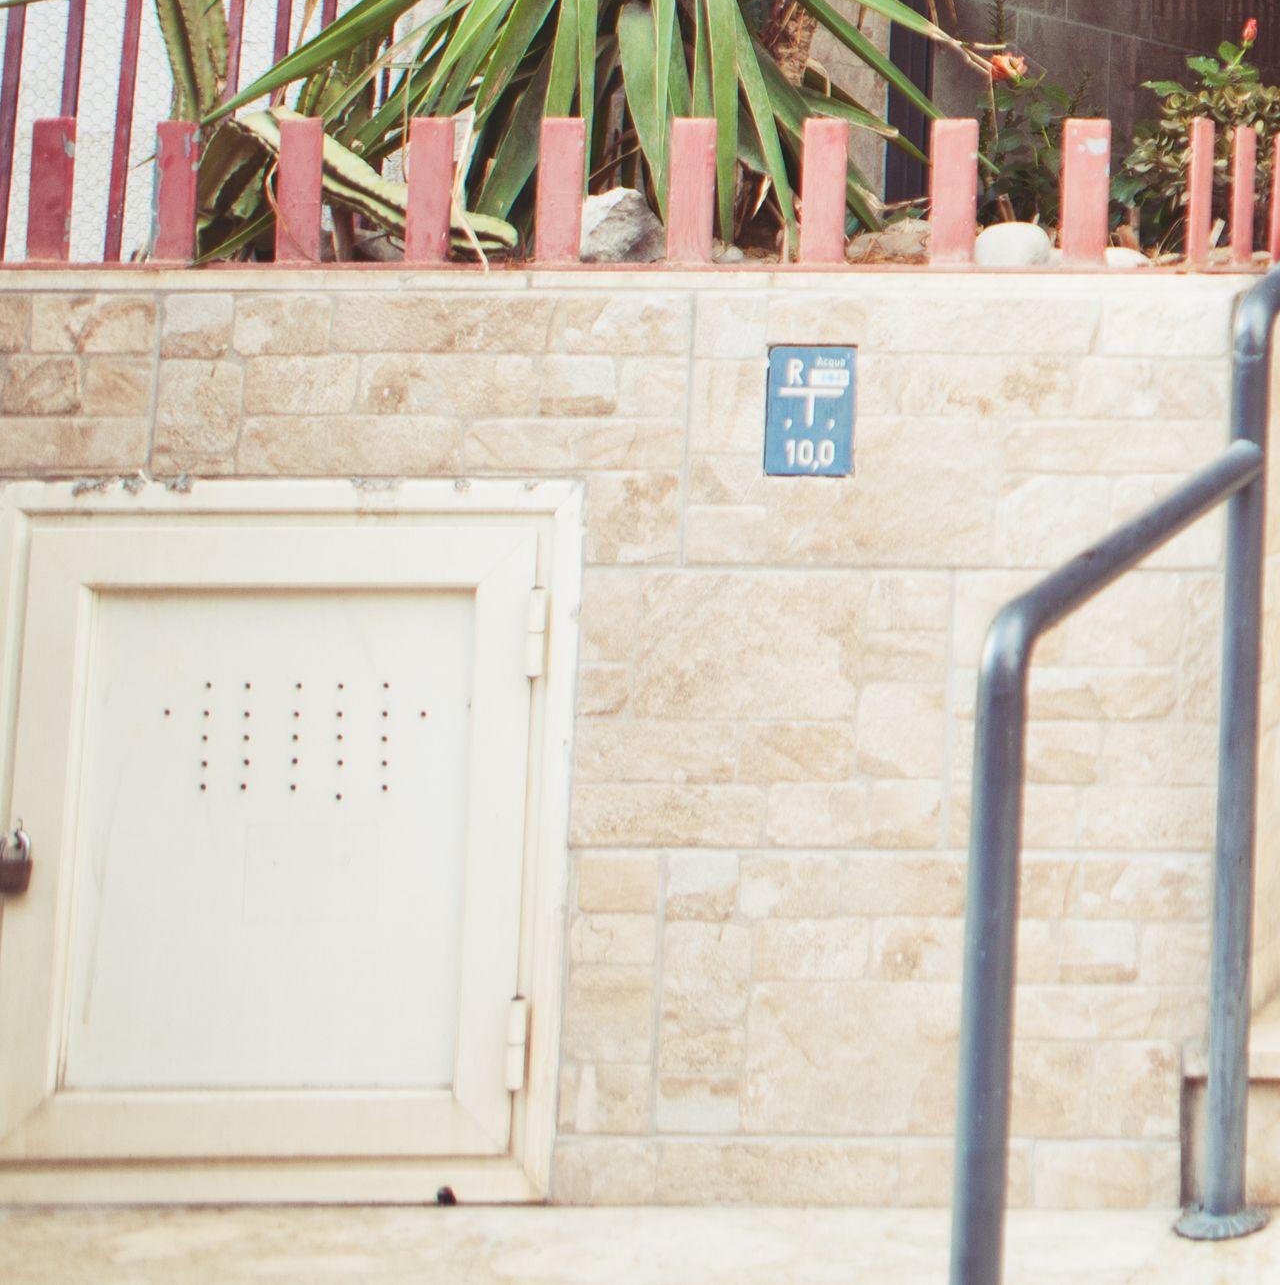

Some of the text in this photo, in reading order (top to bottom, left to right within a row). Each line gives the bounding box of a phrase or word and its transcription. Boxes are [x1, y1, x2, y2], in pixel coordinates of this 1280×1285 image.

[786, 358, 804, 386] R
[816, 356, 846, 368] Acqua
[785, 438, 836, 471] 10,0
